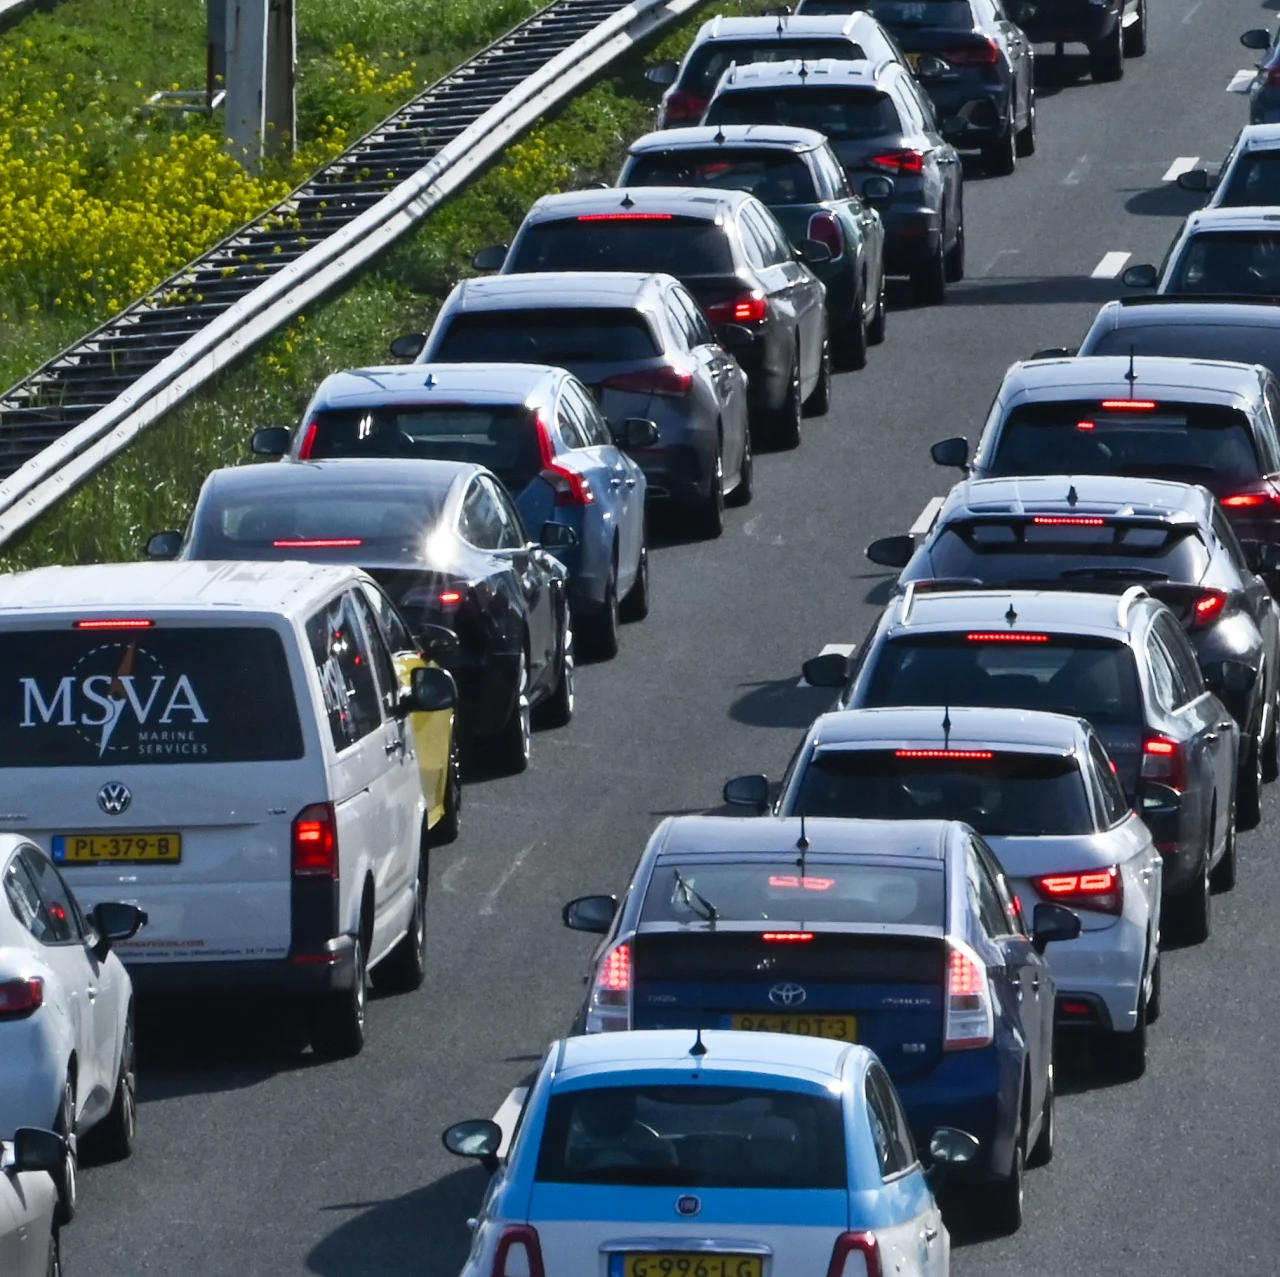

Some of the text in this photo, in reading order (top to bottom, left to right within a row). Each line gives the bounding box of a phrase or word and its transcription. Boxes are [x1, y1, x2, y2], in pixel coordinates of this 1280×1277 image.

[18, 674, 210, 728] MSVA
[138, 730, 196, 741] MARINE
[138, 742, 209, 755] SERVICES
[74, 836, 171, 857] PL-379-B
[631, 1258, 753, 1277] G-996-LG
